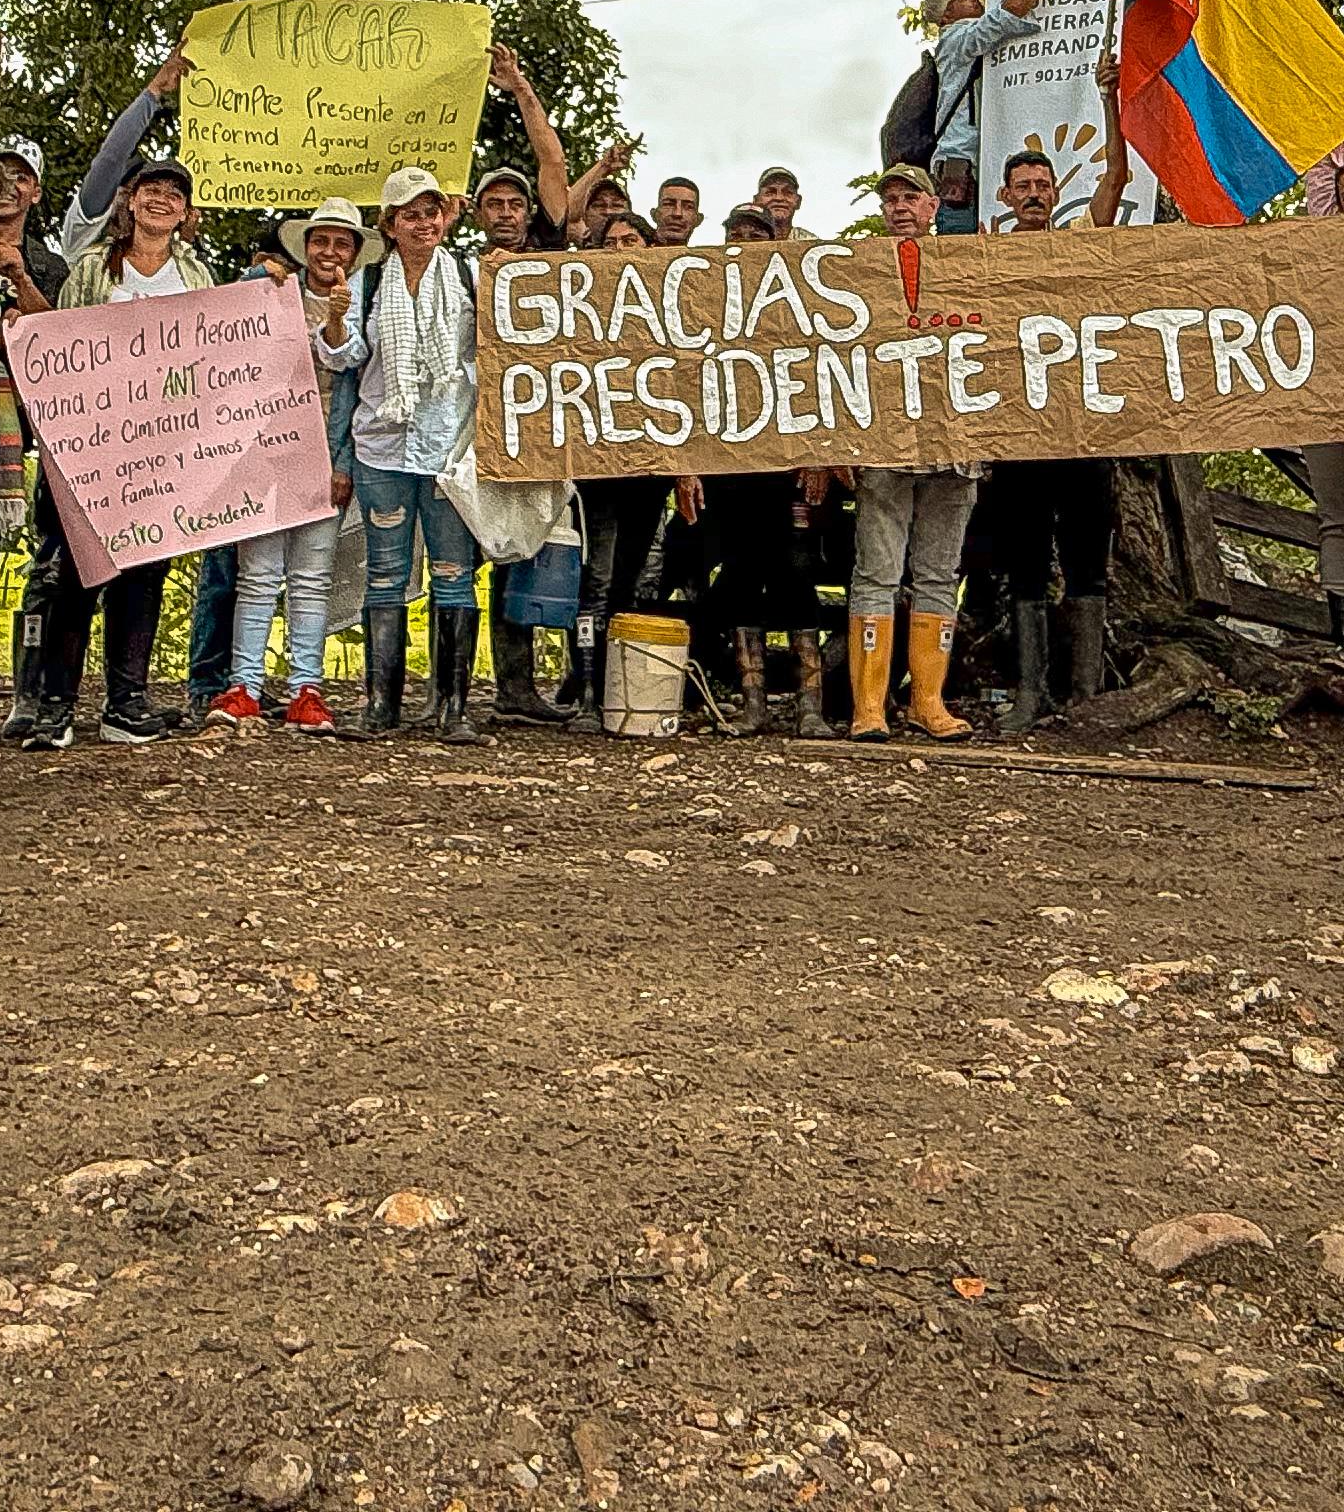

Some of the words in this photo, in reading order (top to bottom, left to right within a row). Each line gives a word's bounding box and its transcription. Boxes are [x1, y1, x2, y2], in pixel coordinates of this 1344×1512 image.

[306, 86, 394, 122] Presente
[404, 110, 426, 124] en
[438, 103, 458, 125] la
[188, 117, 279, 146] Reforma
[301, 126, 369, 157] Agraria
[184, 149, 211, 175] Por
[218, 152, 304, 175] tenernos
[390, 158, 404, 174] a
[25, 333, 112, 384] Gracia
[129, 327, 146, 358] a
[159, 319, 181, 351] la
[195, 310, 272, 347] Reforma
[1018, 304, 1314, 414] PETRO
[96, 386, 112, 411] a
[128, 379, 149, 404] la
[207, 362, 262, 390] Comite
[88, 422, 111, 448] de
[216, 389, 317, 426] Santander
[115, 453, 166, 481] apoyo
[174, 451, 184, 469] y
[193, 440, 243, 461] damos
[253, 429, 301, 449] tierra
[120, 479, 175, 507] familia
[172, 491, 265, 538] Presidente
